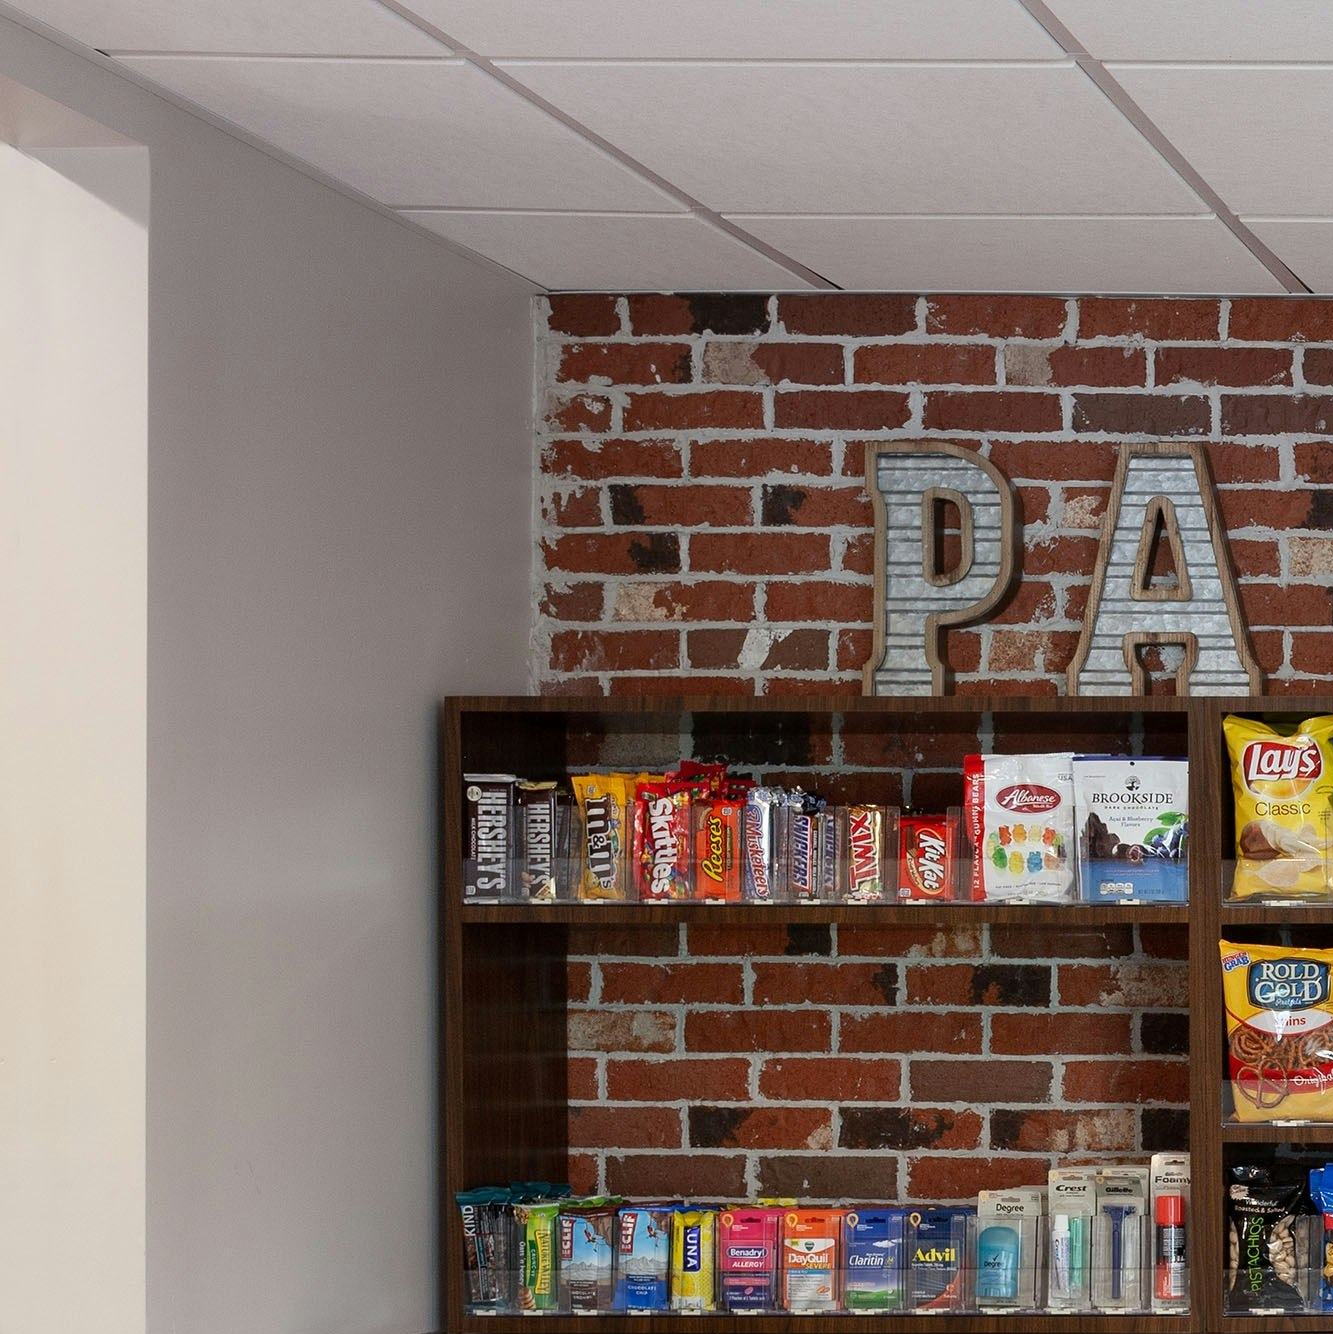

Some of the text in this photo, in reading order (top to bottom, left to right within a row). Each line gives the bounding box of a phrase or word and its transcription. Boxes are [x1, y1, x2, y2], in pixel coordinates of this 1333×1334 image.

[1248, 743, 1319, 782] Lay's
[972, 773, 980, 804] BEARS
[1001, 789, 1057, 807] Albanese
[1092, 792, 1174, 805] BROOKSIDE
[1254, 801, 1311, 817] Classic
[477, 791, 507, 889] HERSHEY'S
[527, 803, 551, 884] HERSHEY'S
[1224, 956, 1250, 972] GRAB
[1261, 963, 1320, 981] ROLD
[1255, 980, 1322, 1003] GOLD
[1055, 1184, 1088, 1192] Crest
[1155, 1175, 1191, 1185] Foamy
[995, 1203, 1025, 1213] Degree
[463, 1204, 476, 1237] KIND
[686, 1228, 699, 1268] UNA
[730, 1248, 765, 1259] Benadryl
[912, 1247, 956, 1262] Advil
[1247, 1216, 1265, 1292] PISTACHIOS
[788, 1253, 829, 1266] DayQuil
[849, 1255, 884, 1266] Claritin
